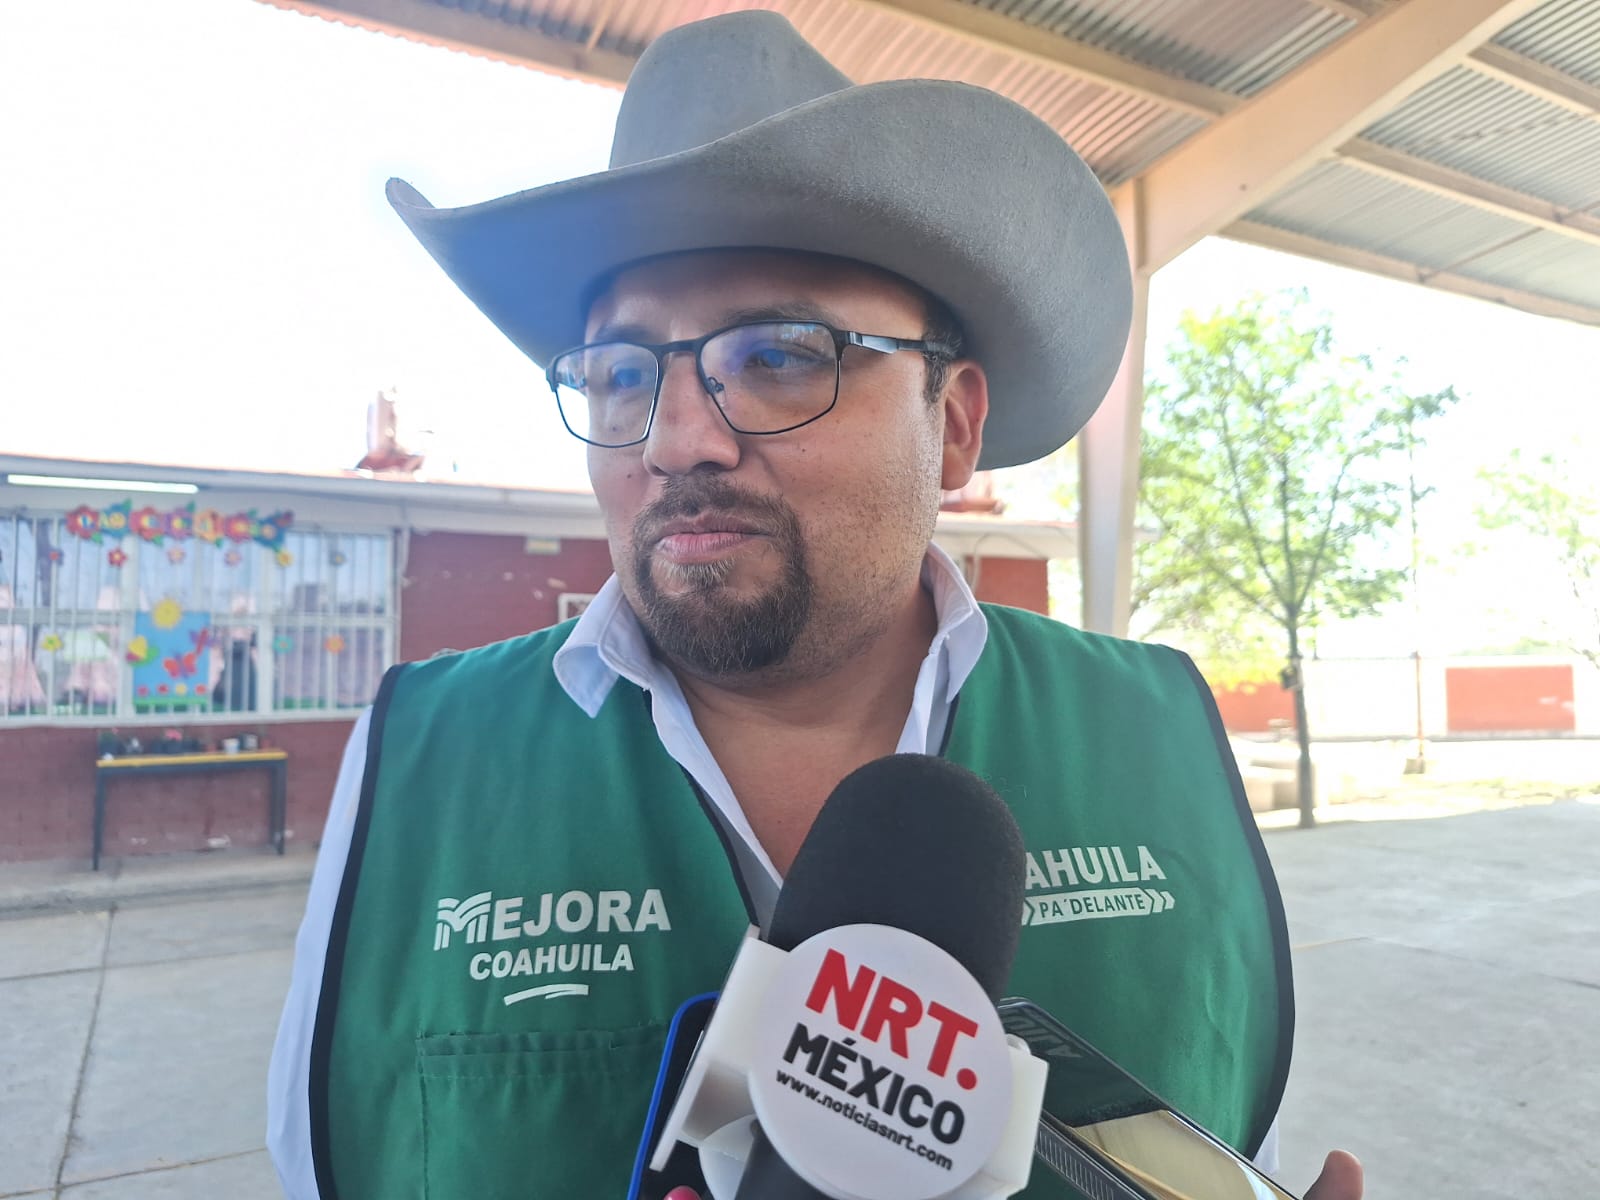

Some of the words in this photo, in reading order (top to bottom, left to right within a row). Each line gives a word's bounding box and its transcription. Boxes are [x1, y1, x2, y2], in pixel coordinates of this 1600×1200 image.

[1024, 845, 1167, 890] AHUILA
[433, 888, 671, 951] MEJORA
[469, 944, 634, 981] COAHUILA
[783, 1022, 965, 1145] MÉXICO
[776, 1069, 953, 1171] www.noticiasnrt.com
